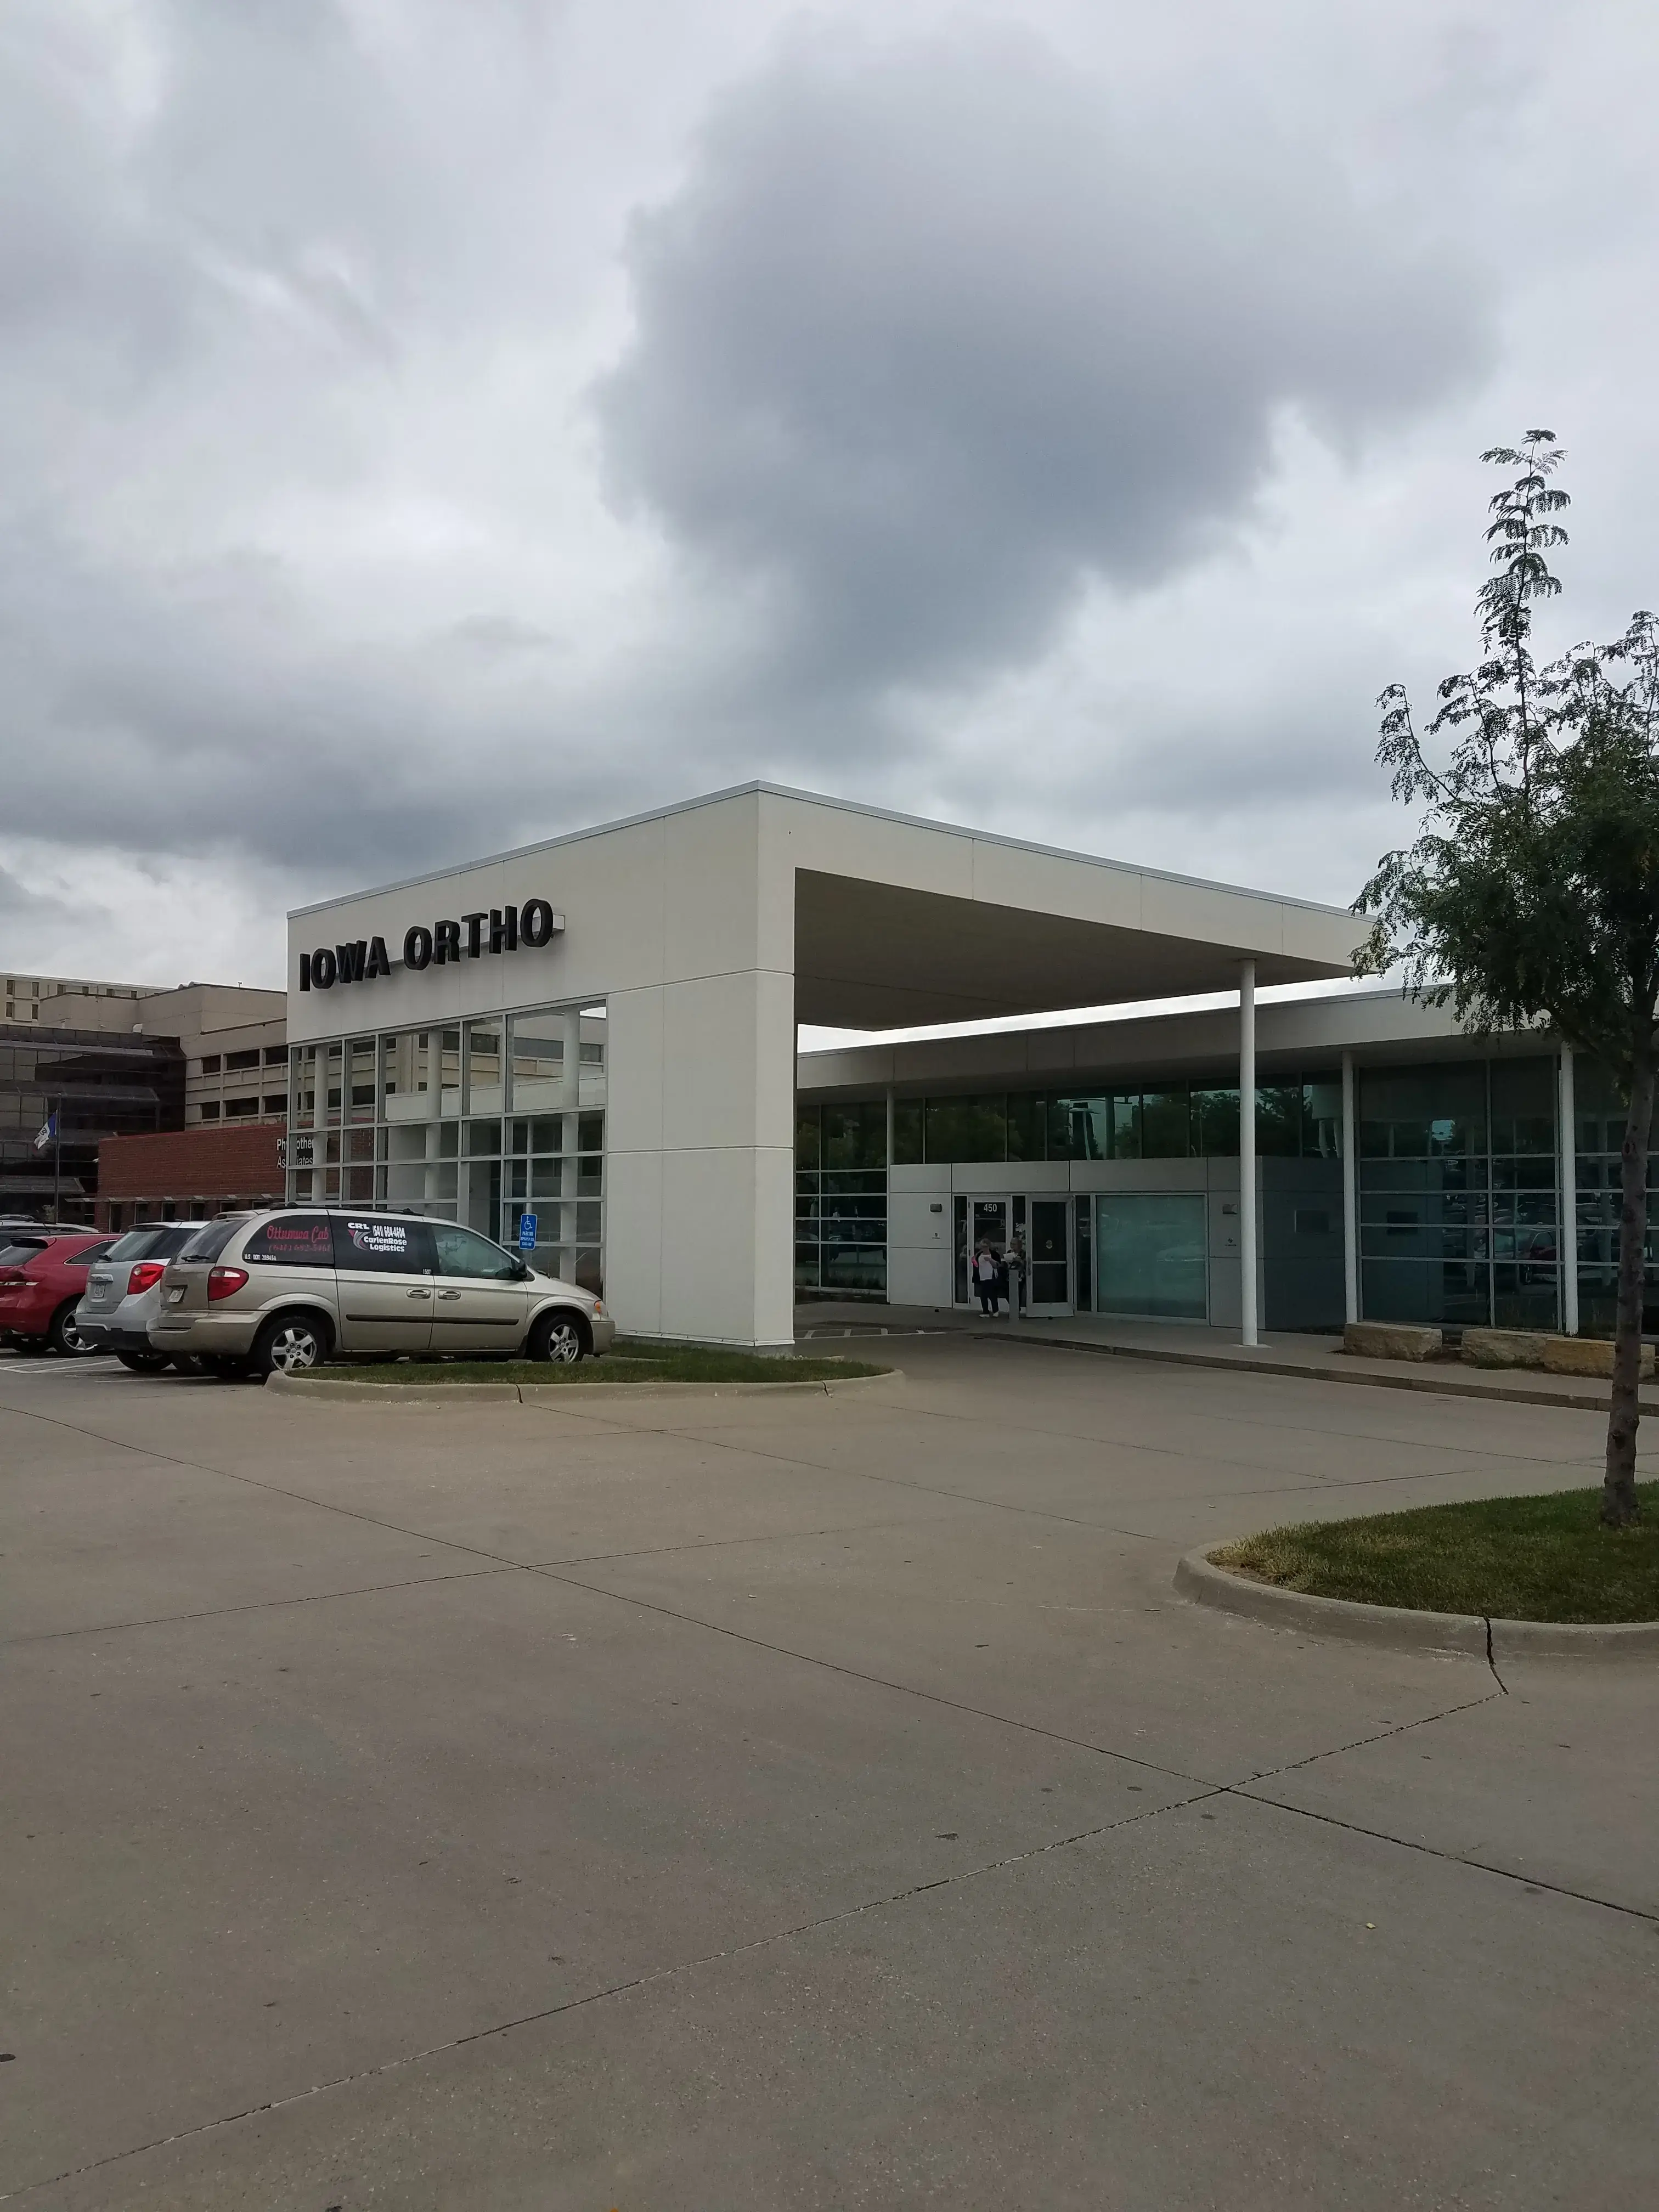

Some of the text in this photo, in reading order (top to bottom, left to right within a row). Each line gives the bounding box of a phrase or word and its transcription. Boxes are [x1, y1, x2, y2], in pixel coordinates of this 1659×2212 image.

[299, 898, 554, 992] IOWA ORTHO
[984, 1204, 997, 1212] 450
[312, 1224, 329, 1243] Cab
[363, 1236, 407, 1245] CarlenRose
[370, 1243, 405, 1252] Logistics
